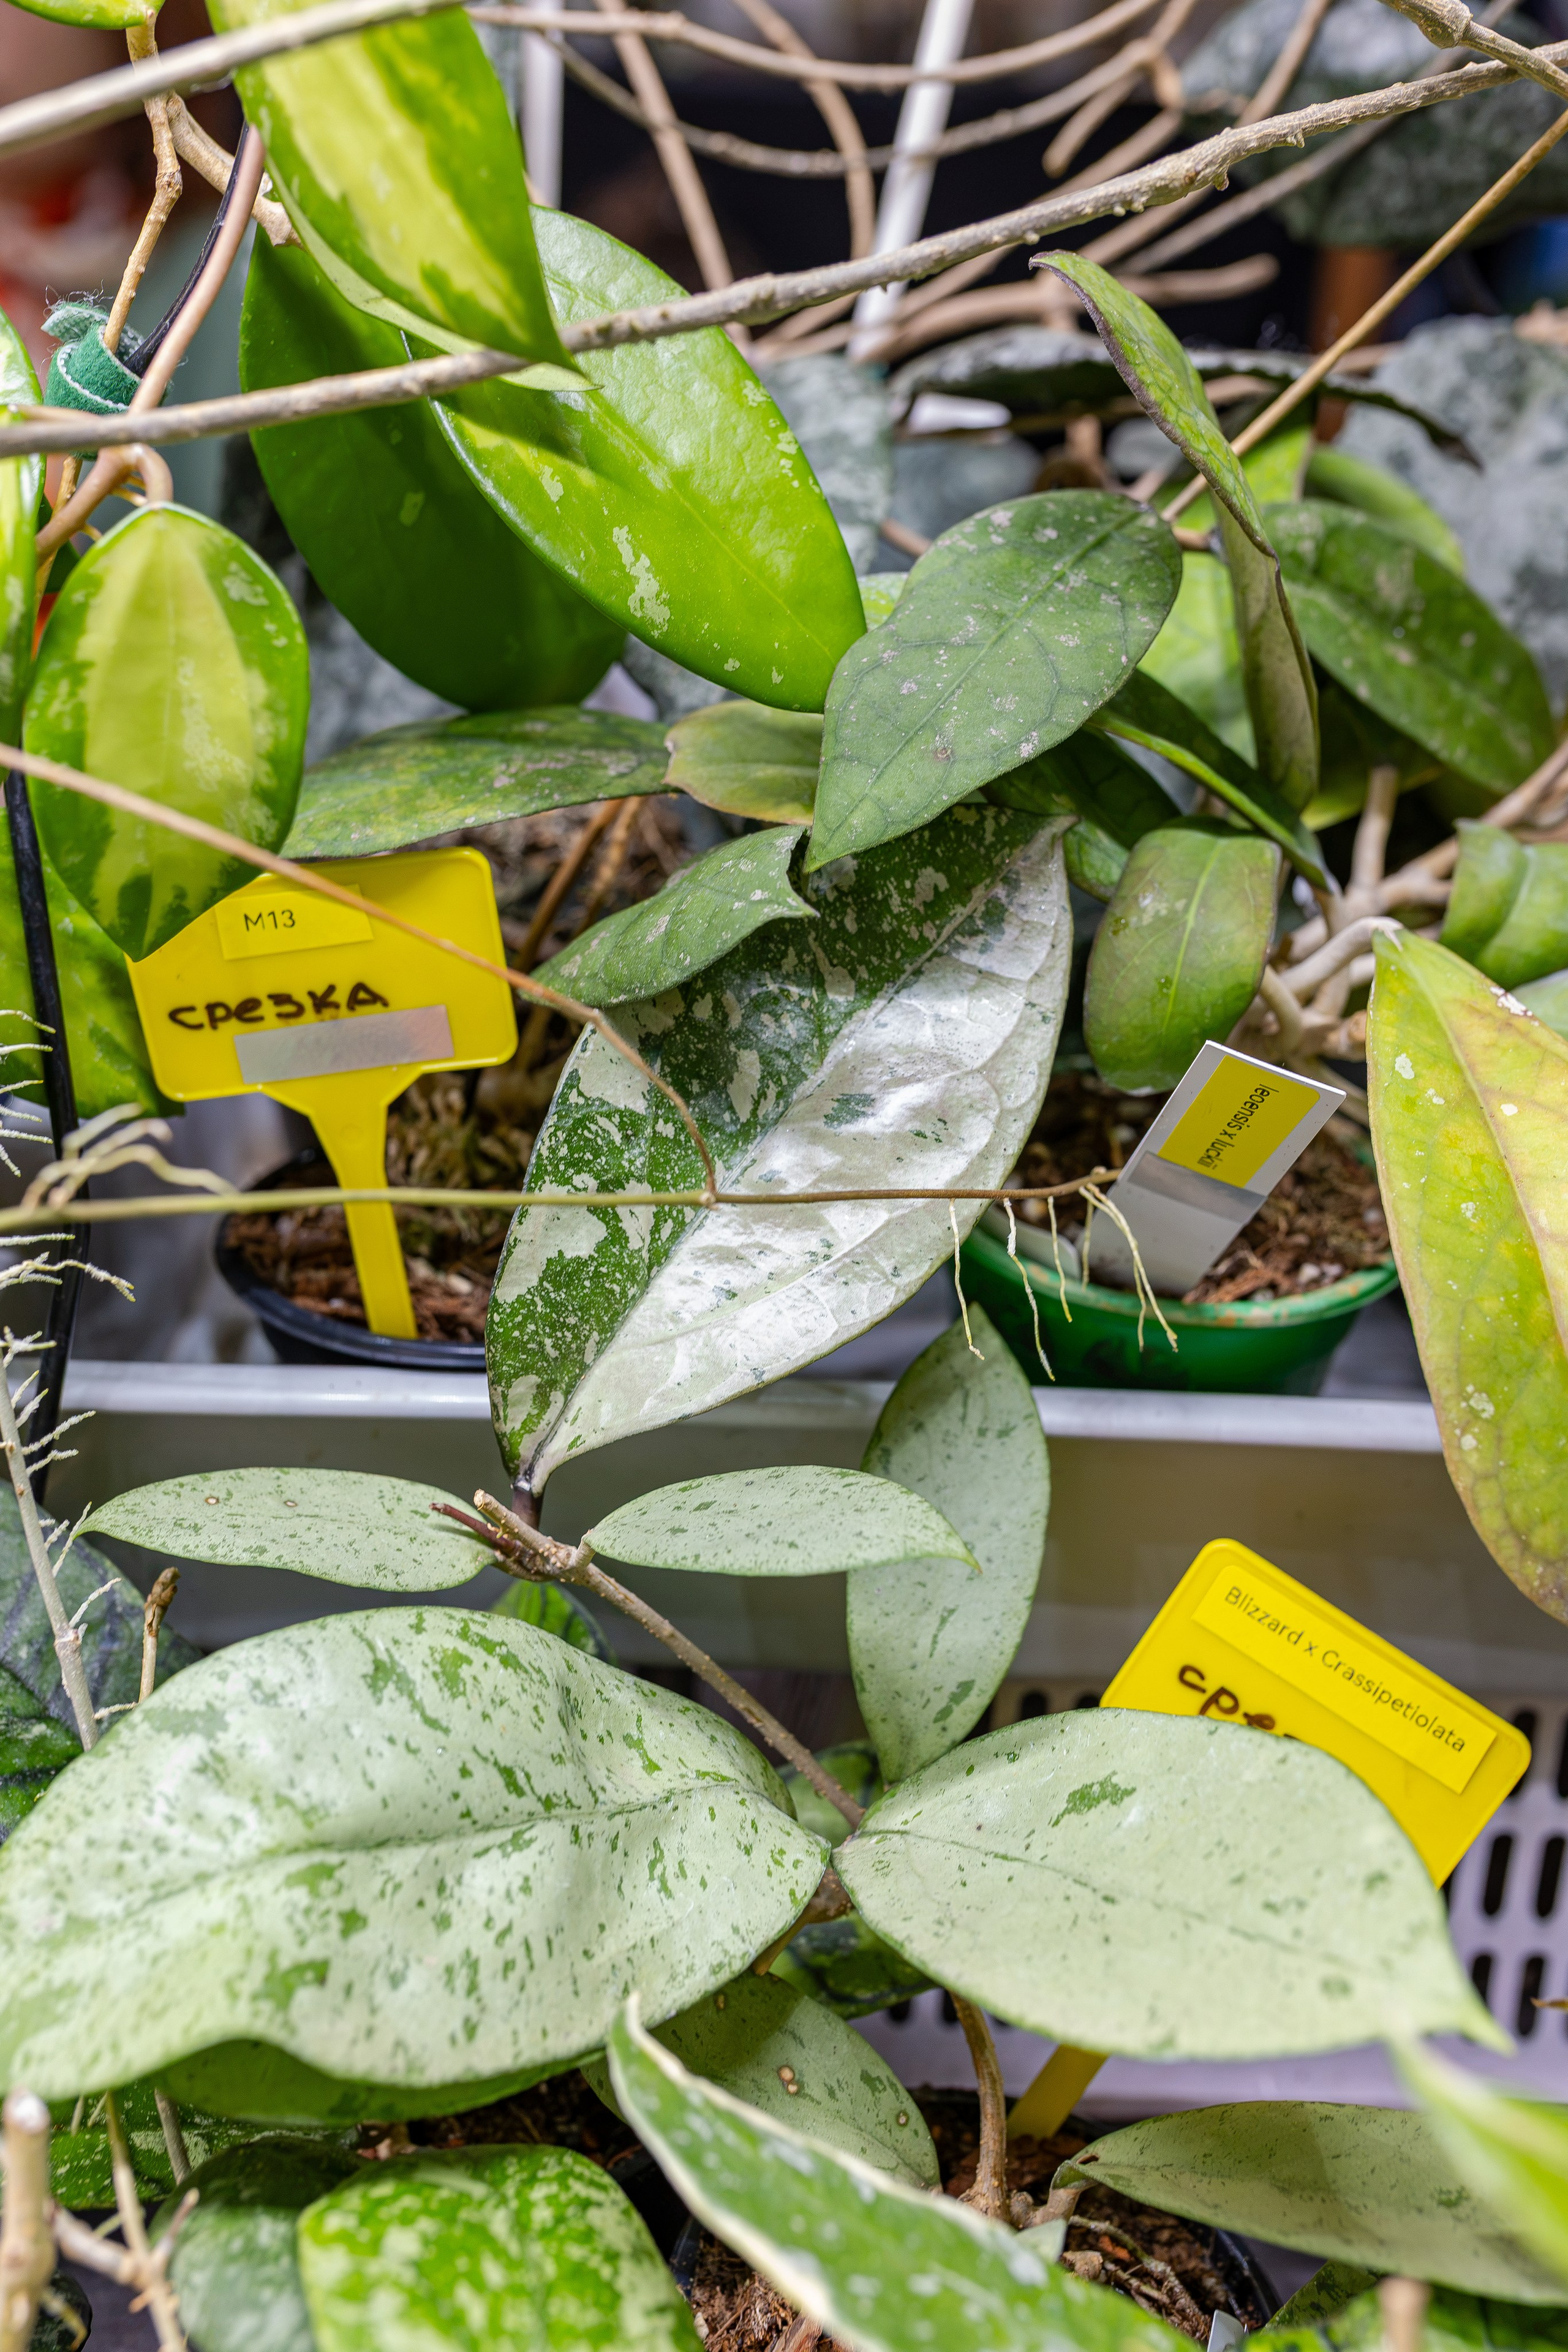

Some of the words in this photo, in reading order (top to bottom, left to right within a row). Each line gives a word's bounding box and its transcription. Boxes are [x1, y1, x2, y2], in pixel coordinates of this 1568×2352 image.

[244, 909, 296, 932] M13
[1219, 1129, 1237, 1140] x
[1225, 1586, 1305, 1646] Blizzard
[1303, 1640, 1319, 1657] x
[1321, 1649, 1466, 1753] Crassipetiolata
